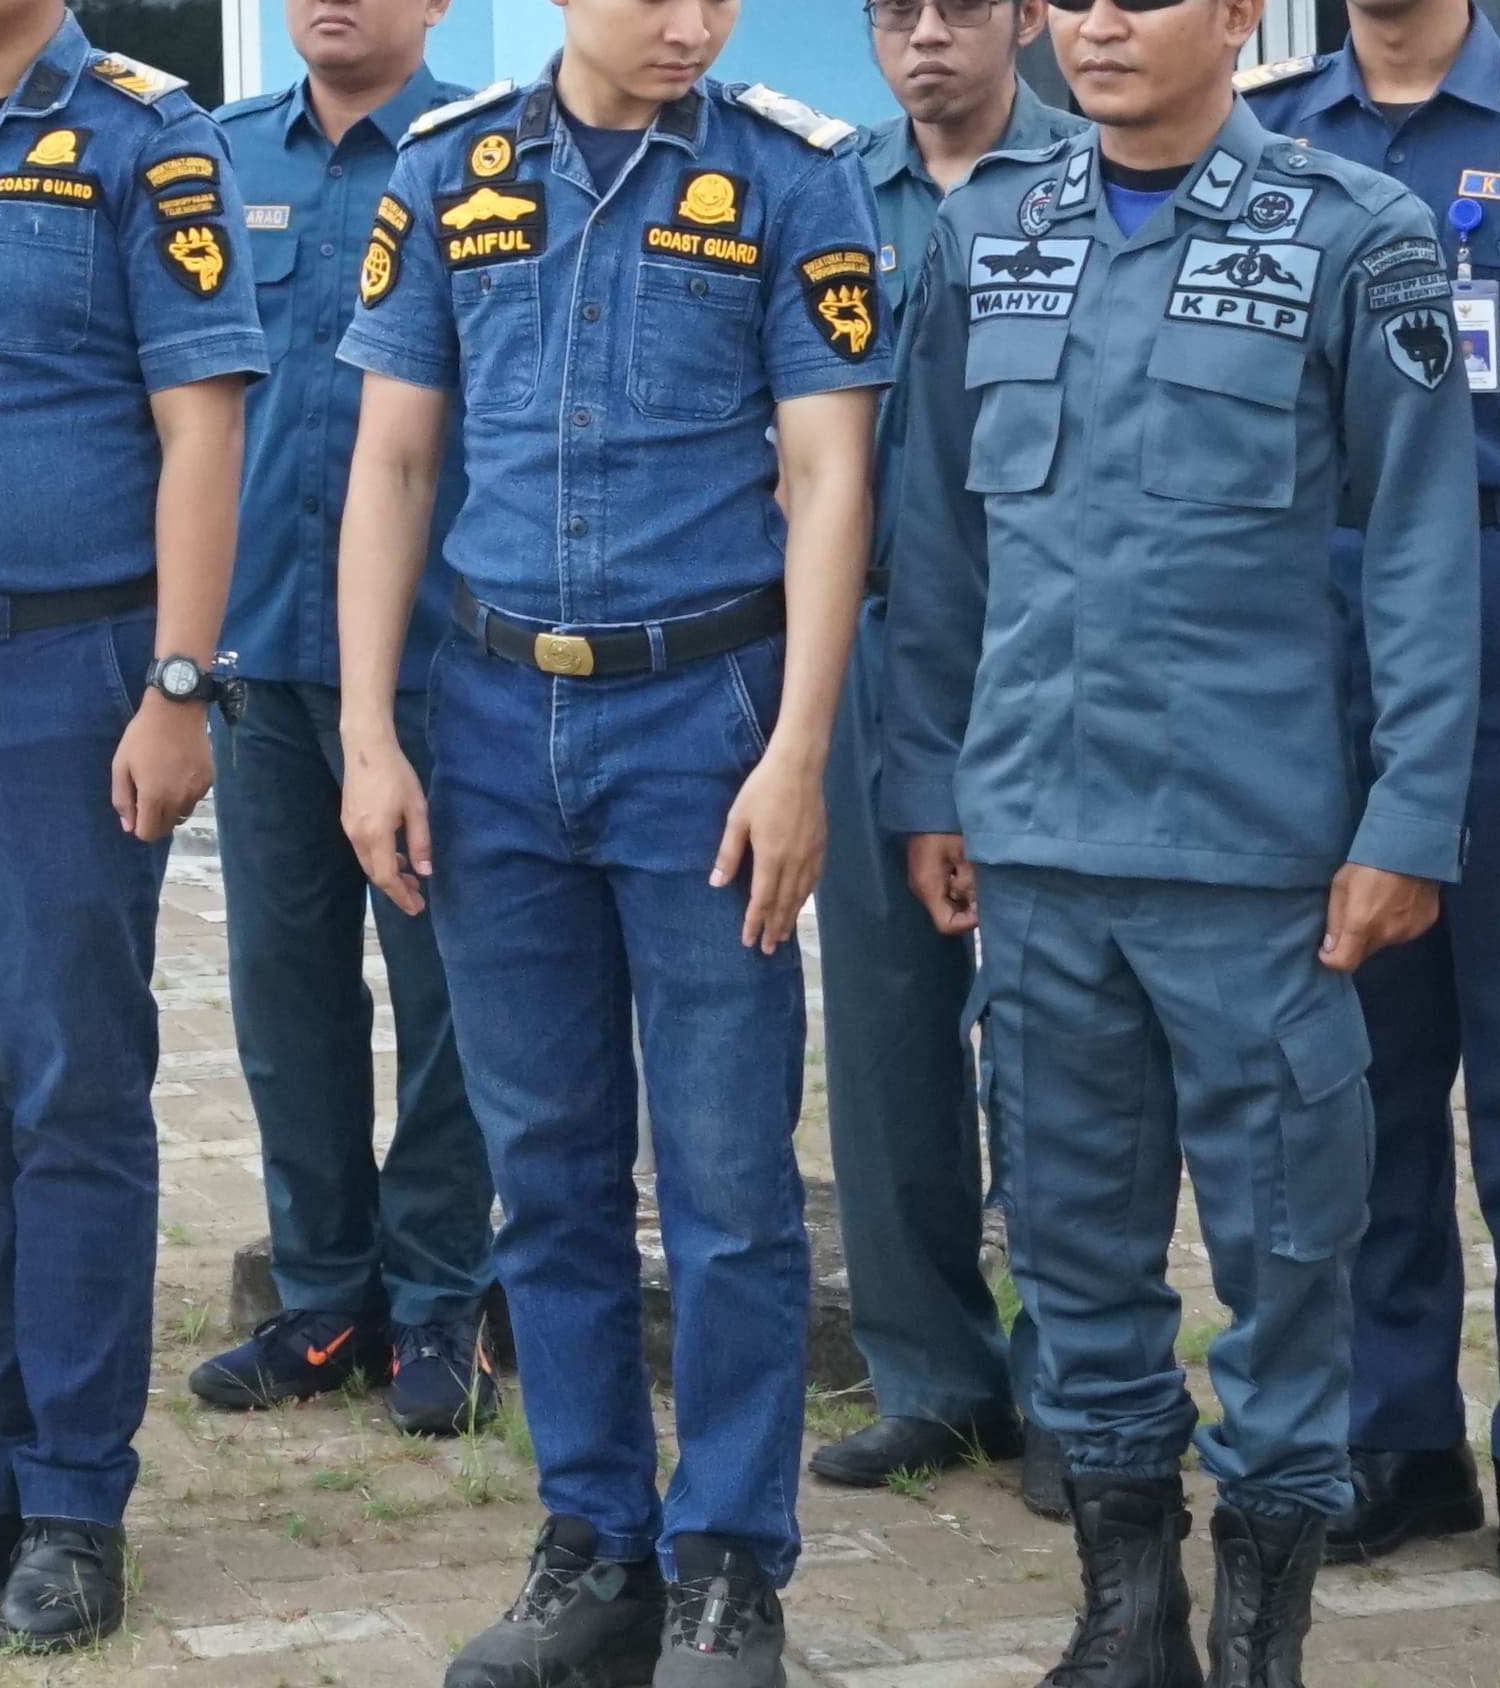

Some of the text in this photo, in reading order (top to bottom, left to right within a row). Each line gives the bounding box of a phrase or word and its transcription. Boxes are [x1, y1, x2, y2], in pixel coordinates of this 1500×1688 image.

[42, 178, 93, 200] GUARD
[449, 229, 532, 260] SAIFUL
[648, 227, 758, 264] COAST GUARD
[975, 292, 1060, 315] WAHYU
[1180, 294, 1297, 330] KPLP
